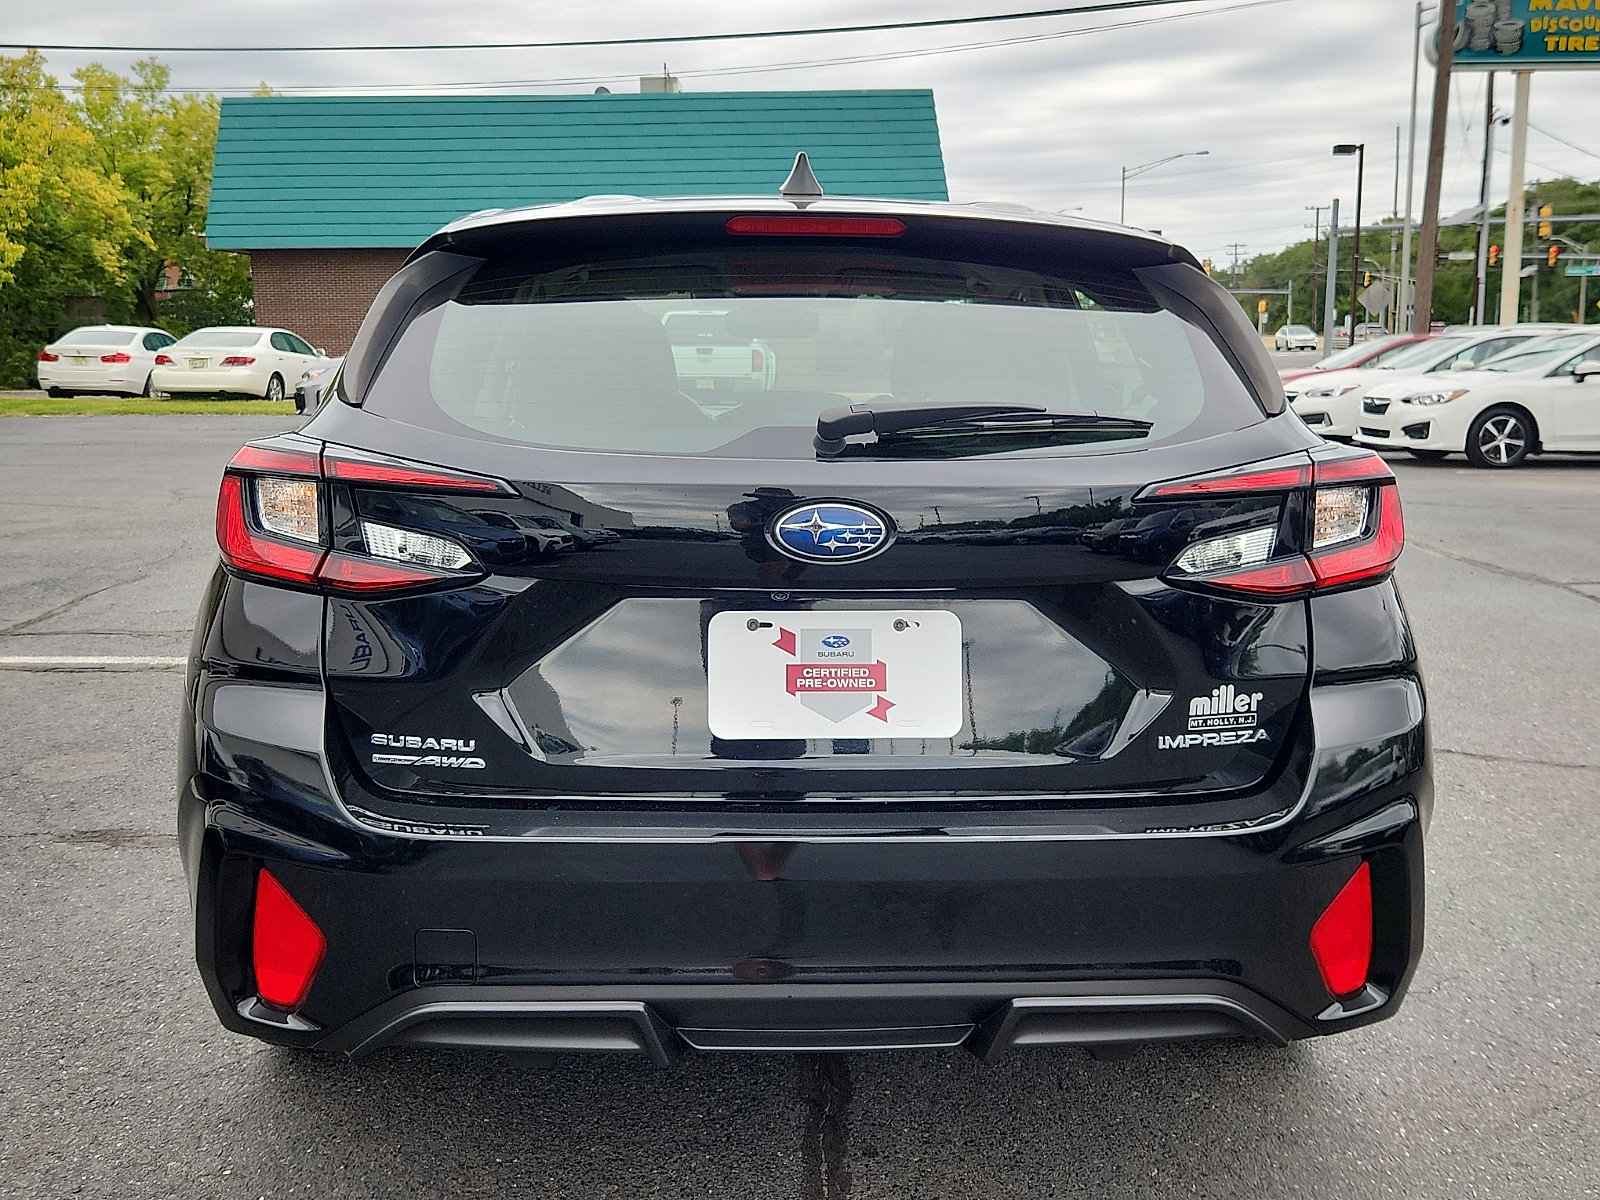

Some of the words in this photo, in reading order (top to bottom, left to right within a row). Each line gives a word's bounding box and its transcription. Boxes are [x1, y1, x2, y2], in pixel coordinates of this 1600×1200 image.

[802, 668, 870, 678] CERTIFIED
[796, 678, 876, 688] PRE-OWNED
[1189, 684, 1264, 716] miller
[1238, 716, 1255, 724] N.J.
[371, 733, 475, 751] SUBARU
[1158, 729, 1271, 749] IMPREZA
[413, 755, 487, 769] AWD
